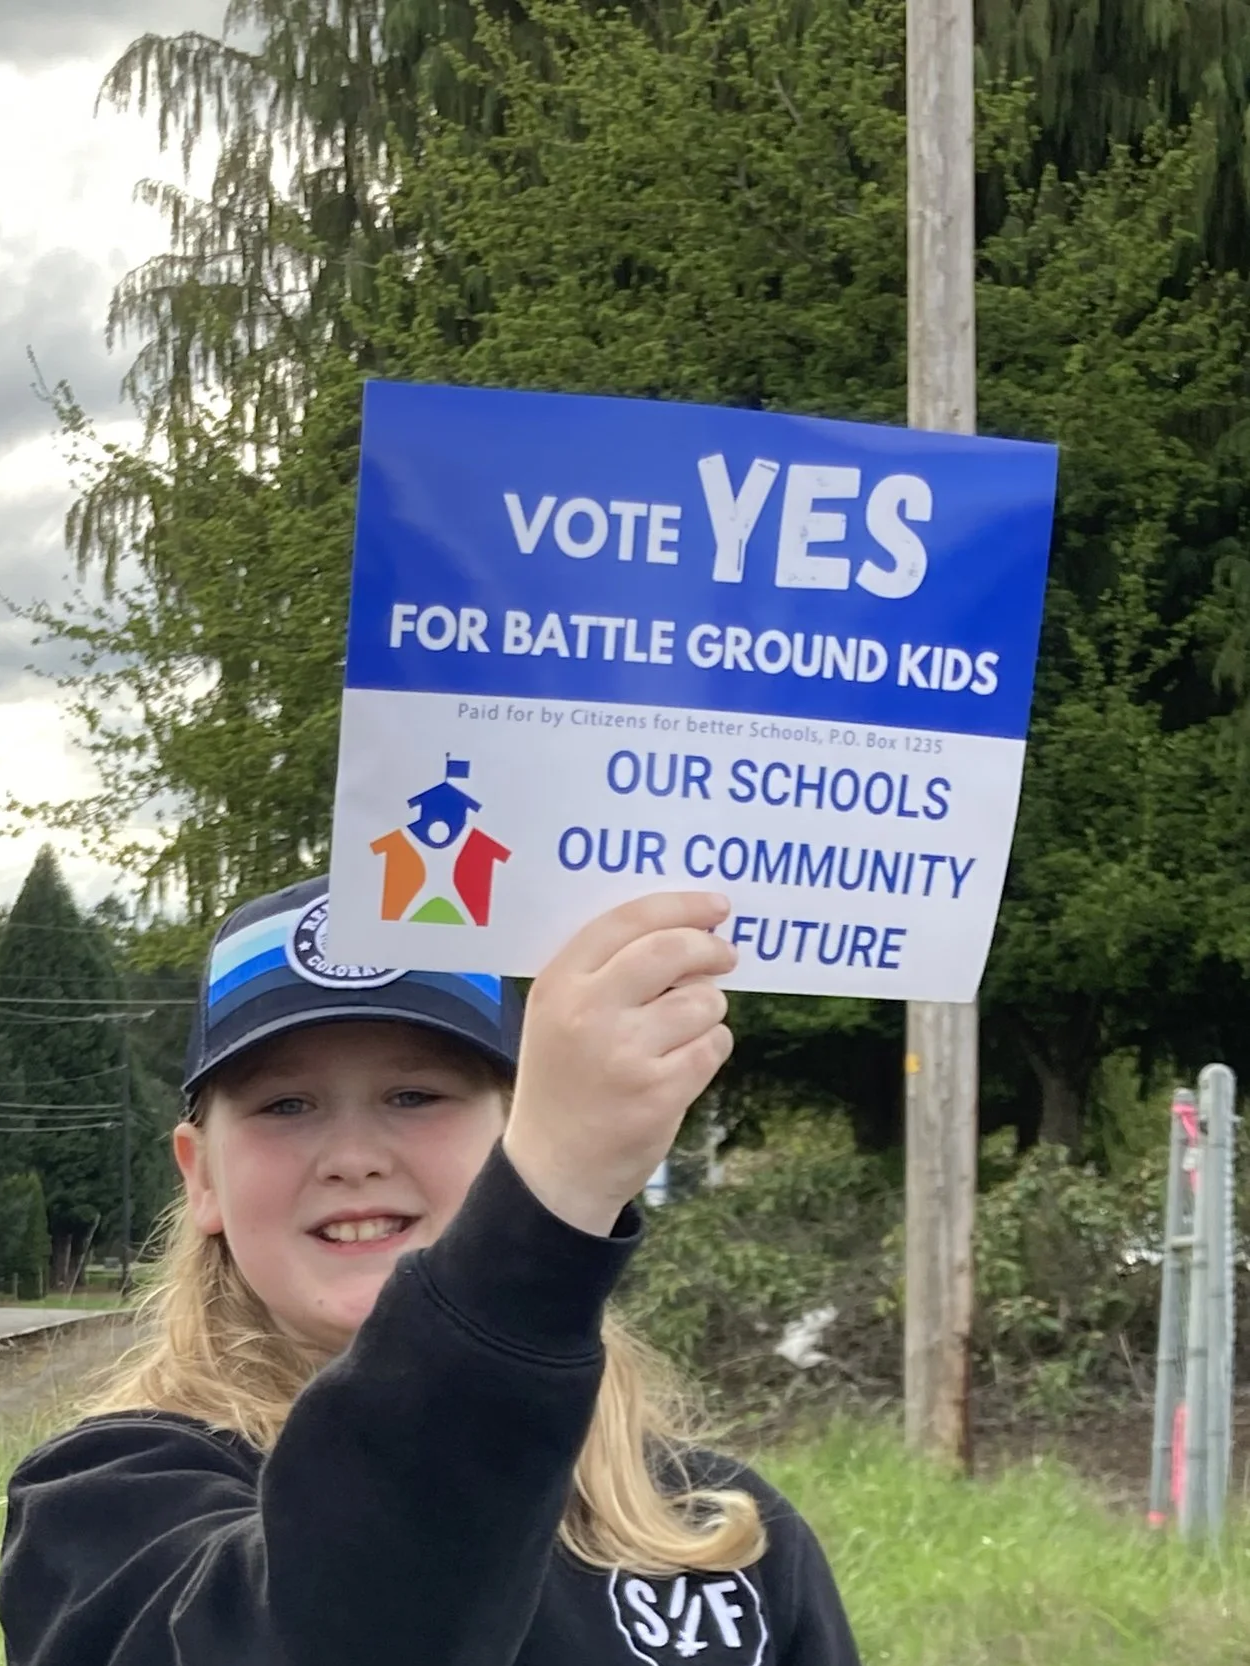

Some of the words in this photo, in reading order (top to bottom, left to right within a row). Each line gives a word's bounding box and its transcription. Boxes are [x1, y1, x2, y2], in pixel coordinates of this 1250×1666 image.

[504, 494, 681, 564] VOTE
[698, 454, 932, 598] YES
[391, 604, 489, 652] FOR
[504, 611, 675, 664] BATTLE
[687, 624, 887, 682] GROUND
[898, 644, 998, 694] KIDS
[458, 703, 499, 720] Paid
[507, 705, 534, 722] for
[542, 707, 564, 728] by
[571, 709, 647, 730] Citizens
[654, 714, 680, 731] for
[686, 716, 743, 737] better
[750, 721, 823, 745] Schools,
[829, 728, 860, 747] P.O.
[866, 732, 897, 750] Box
[905, 736, 943, 754] 1235
[607, 750, 711, 799] OUR
[729, 759, 950, 820] SCHOOLS
[558, 827, 666, 874] OUR
[685, 835, 975, 898] COMMUNITY
[734, 916, 906, 969] FUTURE
